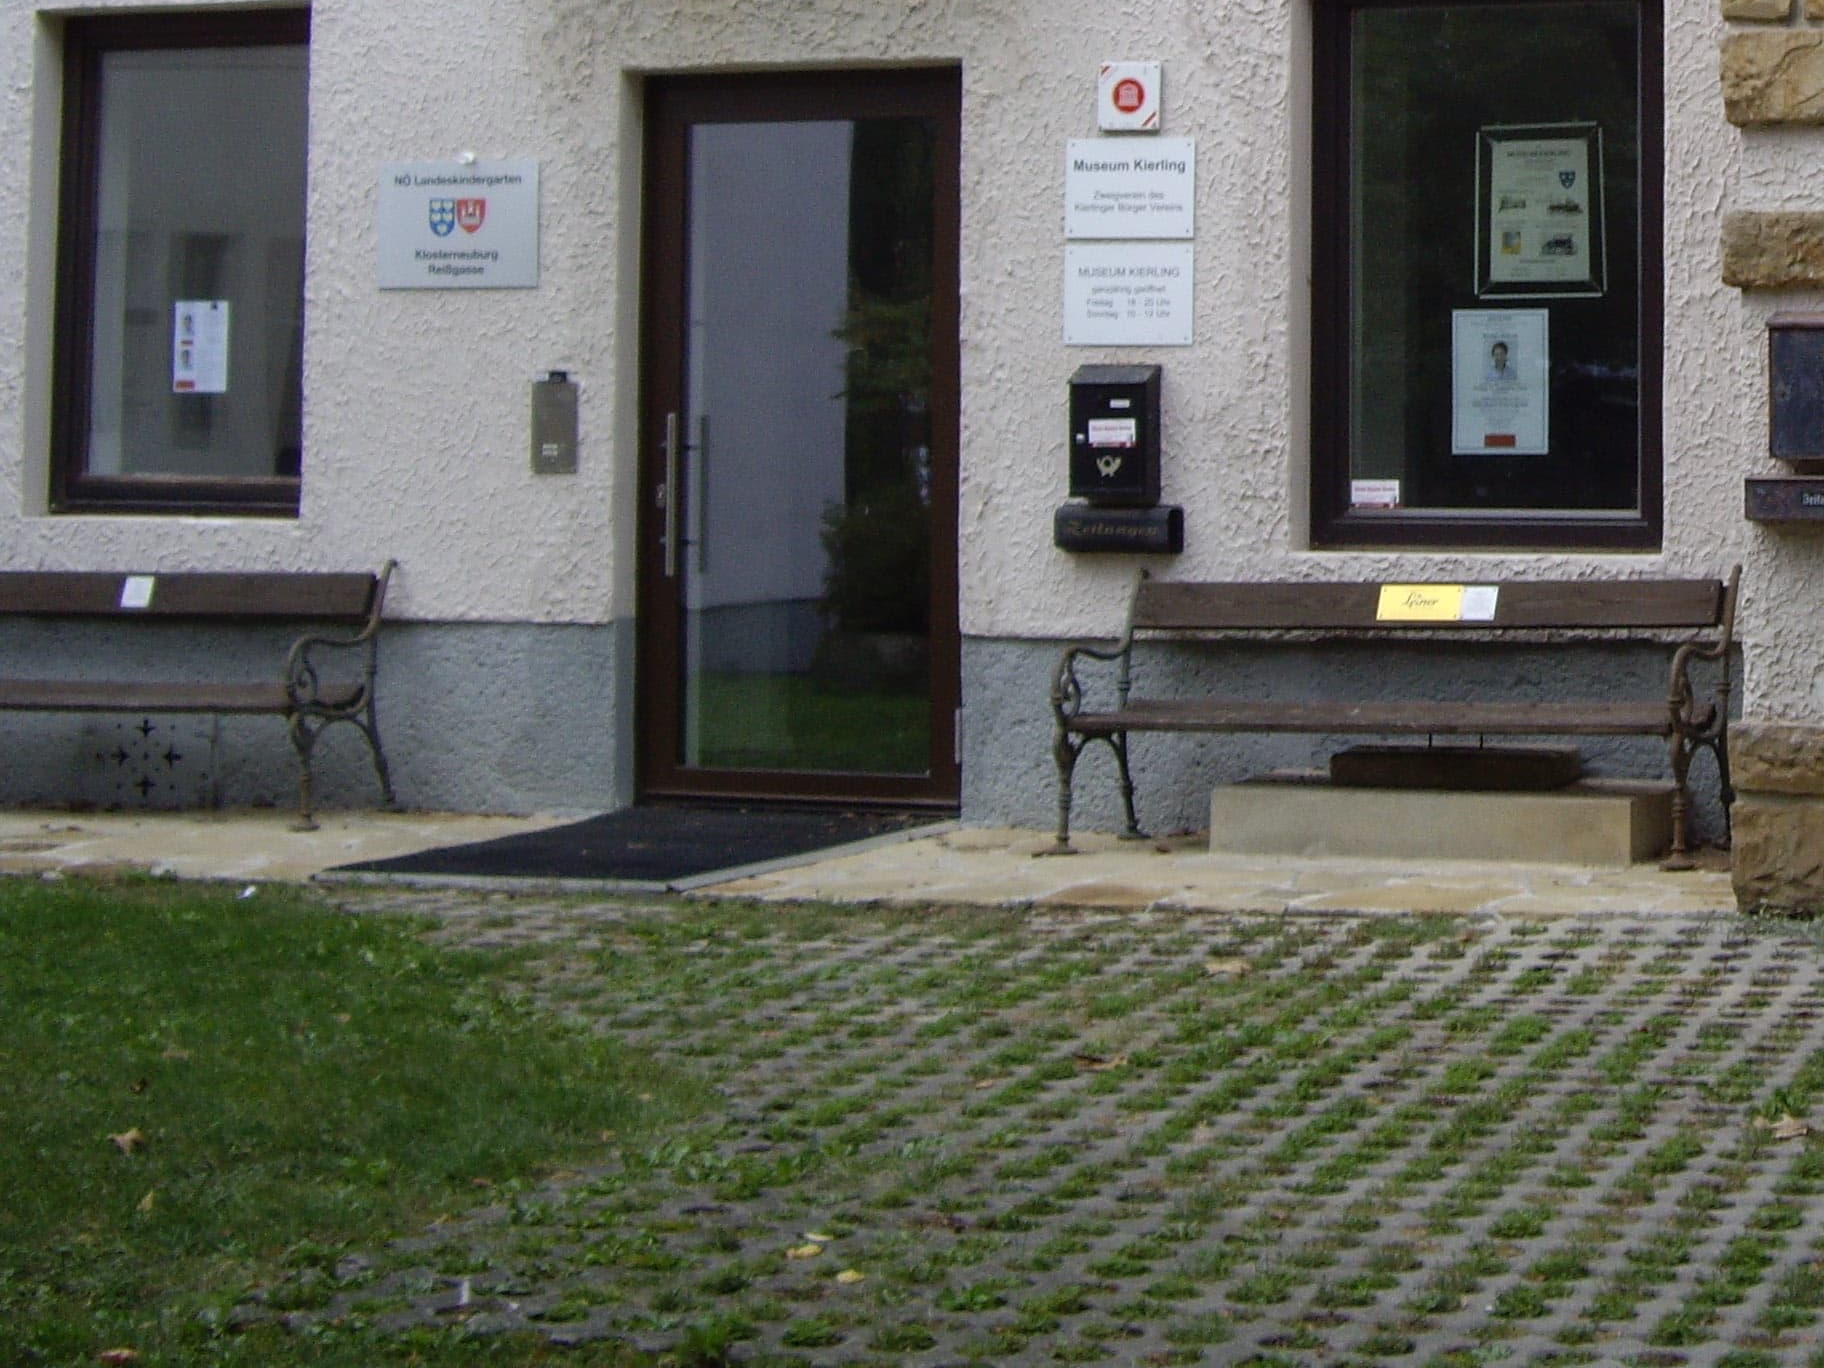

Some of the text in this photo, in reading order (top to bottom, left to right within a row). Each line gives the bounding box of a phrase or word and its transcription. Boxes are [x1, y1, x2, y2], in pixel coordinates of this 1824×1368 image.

[1073, 159, 1186, 174] Museum Kierling
[394, 173, 522, 188] NÖ Landeskindergarten
[414, 248, 499, 262] Klosterneuburg
[1078, 266, 1180, 278] MUSEUM KIERLING
